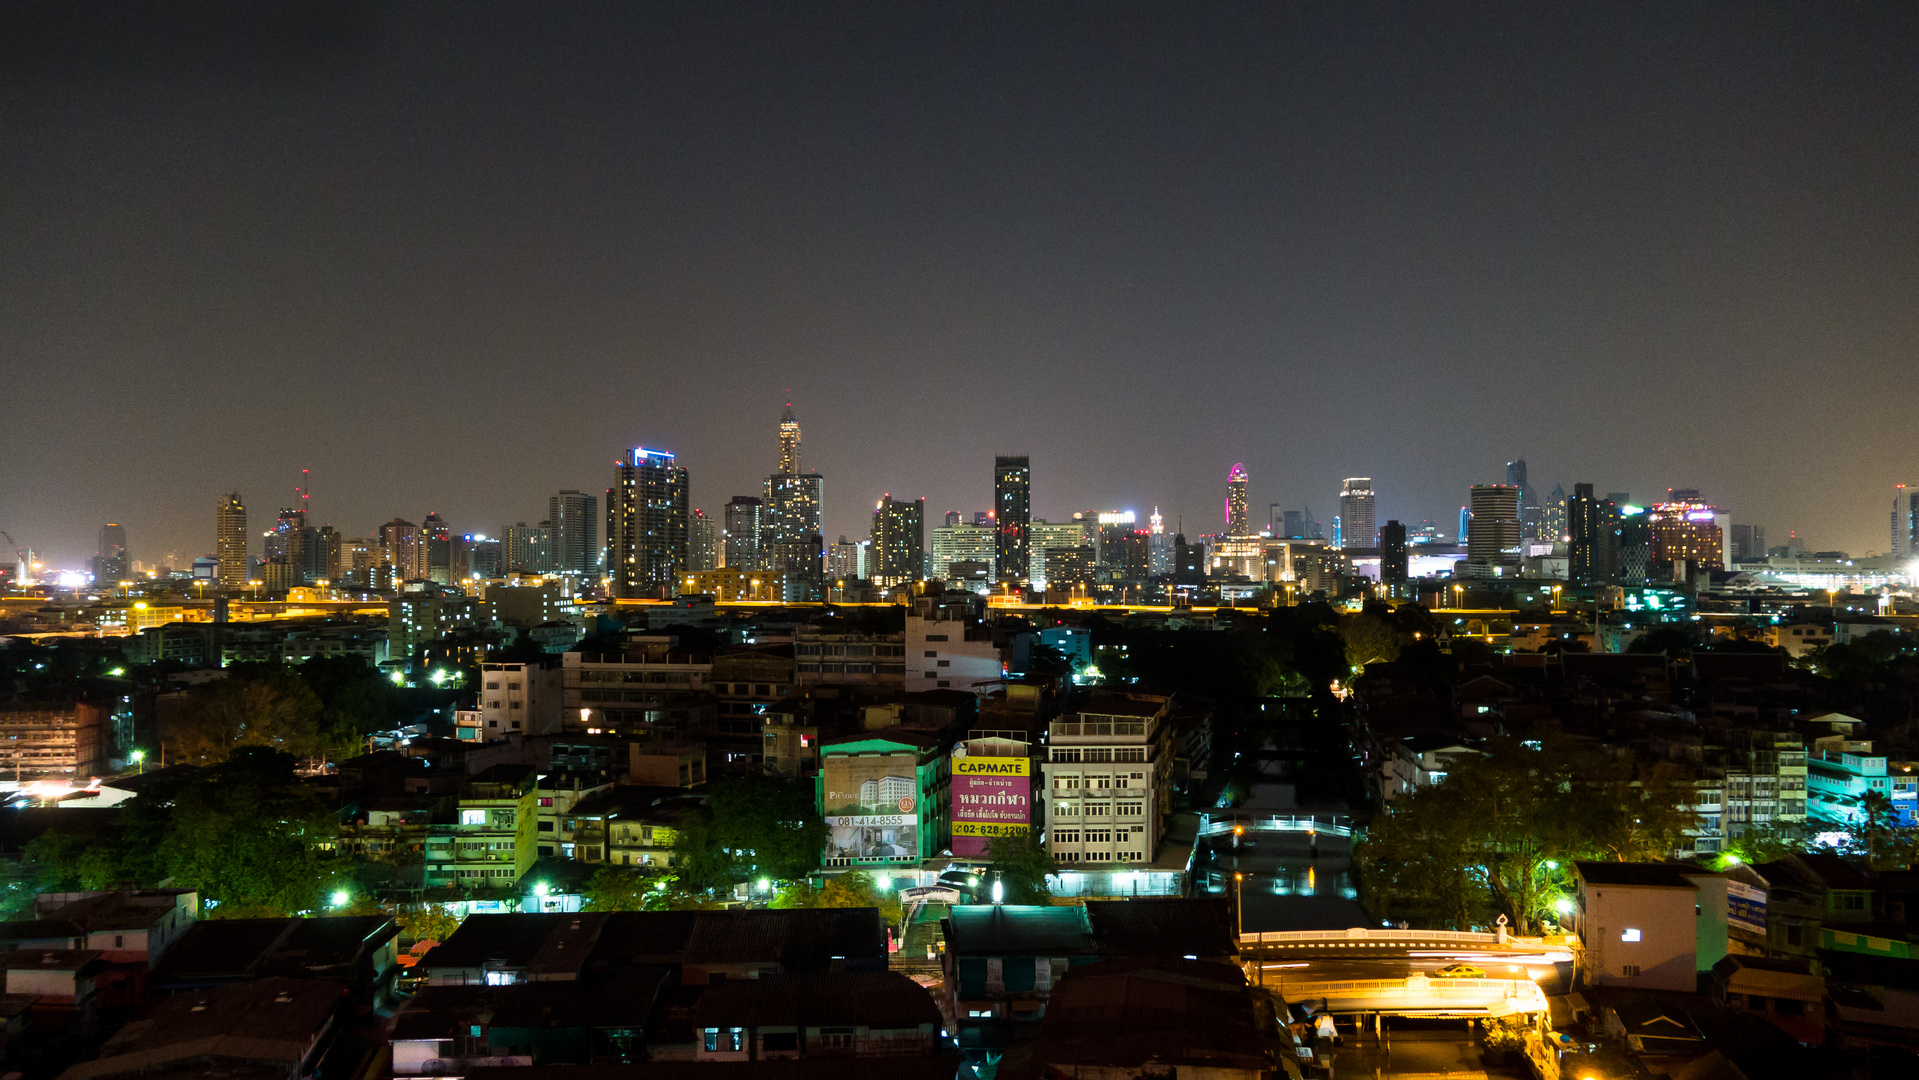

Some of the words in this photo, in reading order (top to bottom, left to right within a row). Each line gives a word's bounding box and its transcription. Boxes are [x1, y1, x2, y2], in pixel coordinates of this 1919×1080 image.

[958, 763, 1022, 773] CAPMATE
[959, 790, 1026, 806] หมวกกีฬา
[838, 816, 903, 826] 081-414-8555
[963, 824, 1028, 835] 02-628-1209
